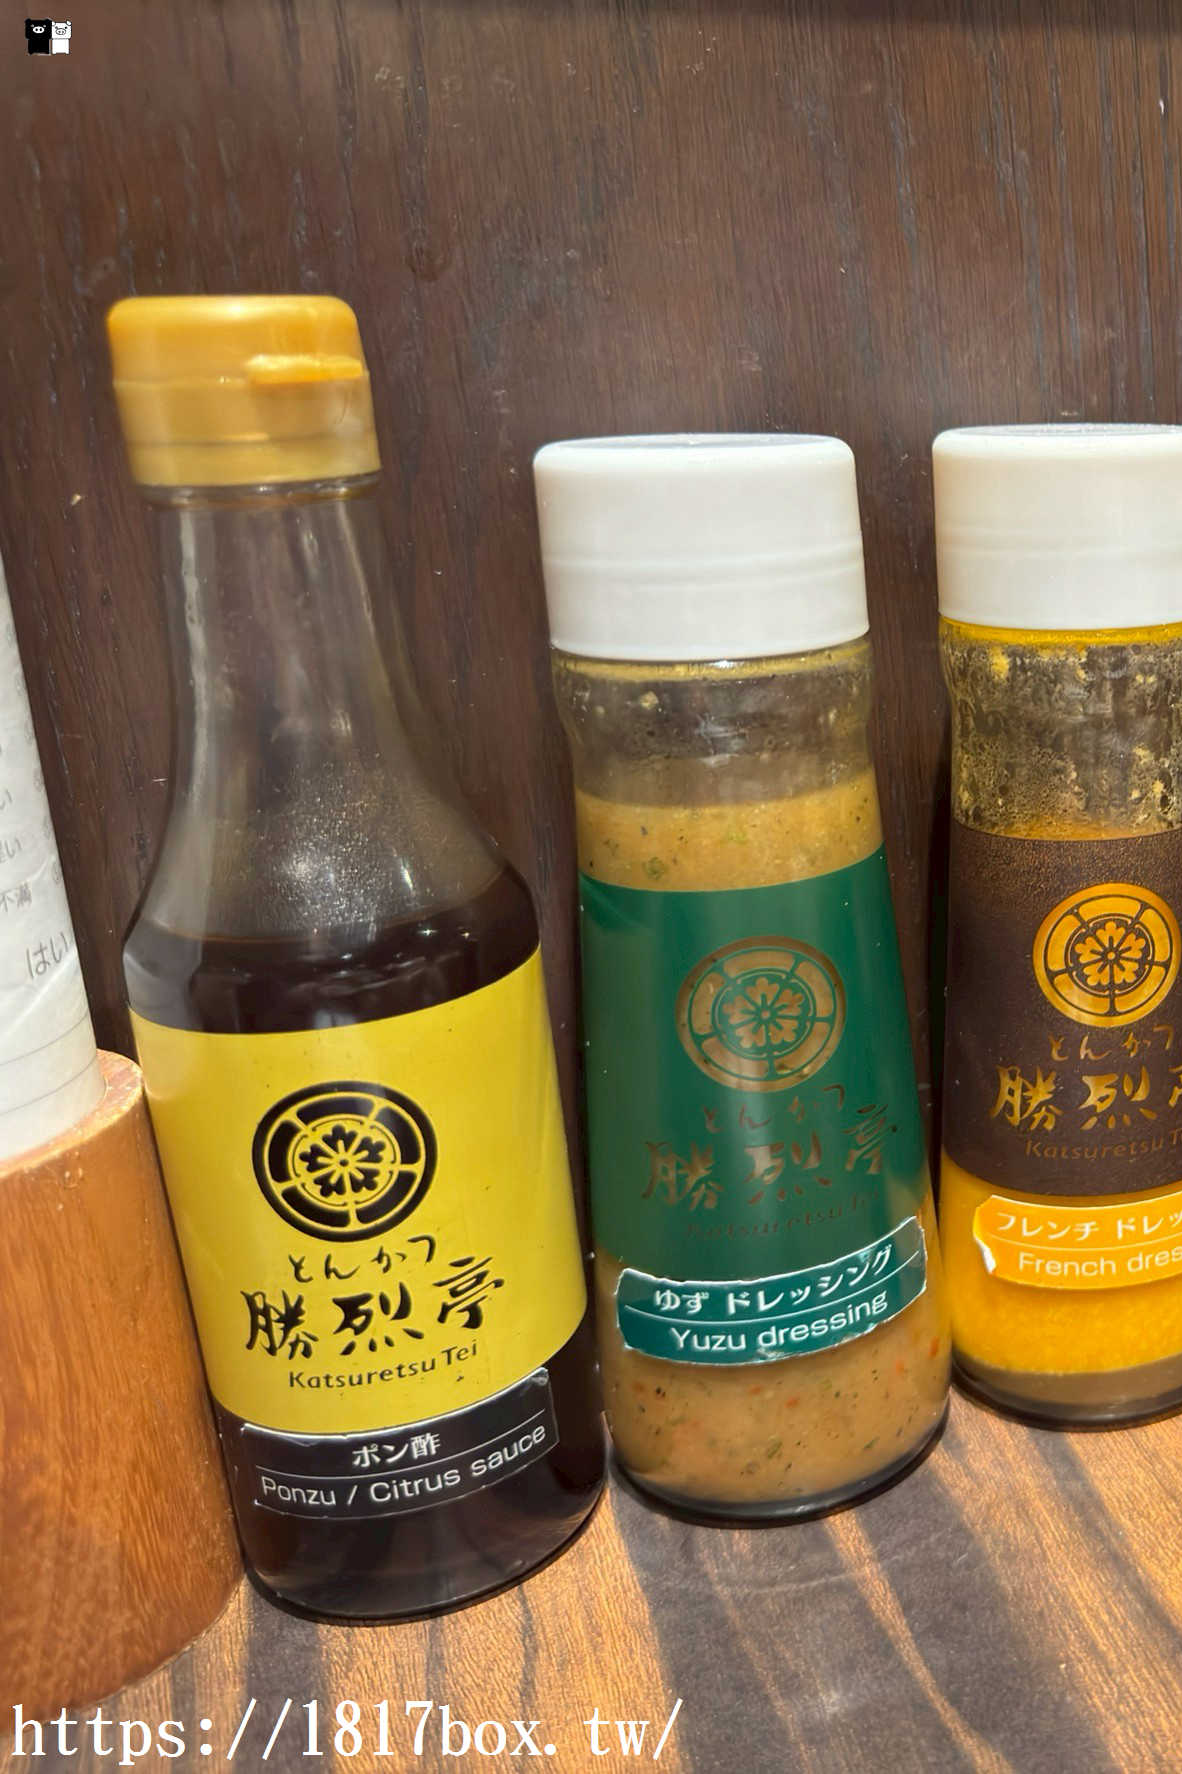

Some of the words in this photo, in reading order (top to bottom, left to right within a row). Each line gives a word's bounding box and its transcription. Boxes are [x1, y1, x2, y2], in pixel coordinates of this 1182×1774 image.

[26, 931, 69, 980] はい
[1050, 1024, 1175, 1063] とんかつ
[641, 1104, 897, 1211] 勝烈亭
[1025, 1137, 1165, 1161] Katsuretsu
[996, 1211, 1100, 1241] フレンチ
[287, 1233, 437, 1284] とんかつ
[654, 1288, 710, 1315] ゆず
[727, 1243, 894, 1316] ドレッシング
[1017, 1251, 1117, 1278] French
[239, 1255, 505, 1361] 勝烈亭
[671, 1326, 747, 1352] Yuzu
[758, 1289, 889, 1348] dressing
[288, 1360, 436, 1389] Katsuretsu
[441, 1338, 479, 1367] Tei
[261, 1475, 337, 1506] Ponzu
[369, 1469, 461, 1503] Citrus
[470, 1423, 546, 1478] sauce
[351, 1432, 441, 1469] ポン酢
